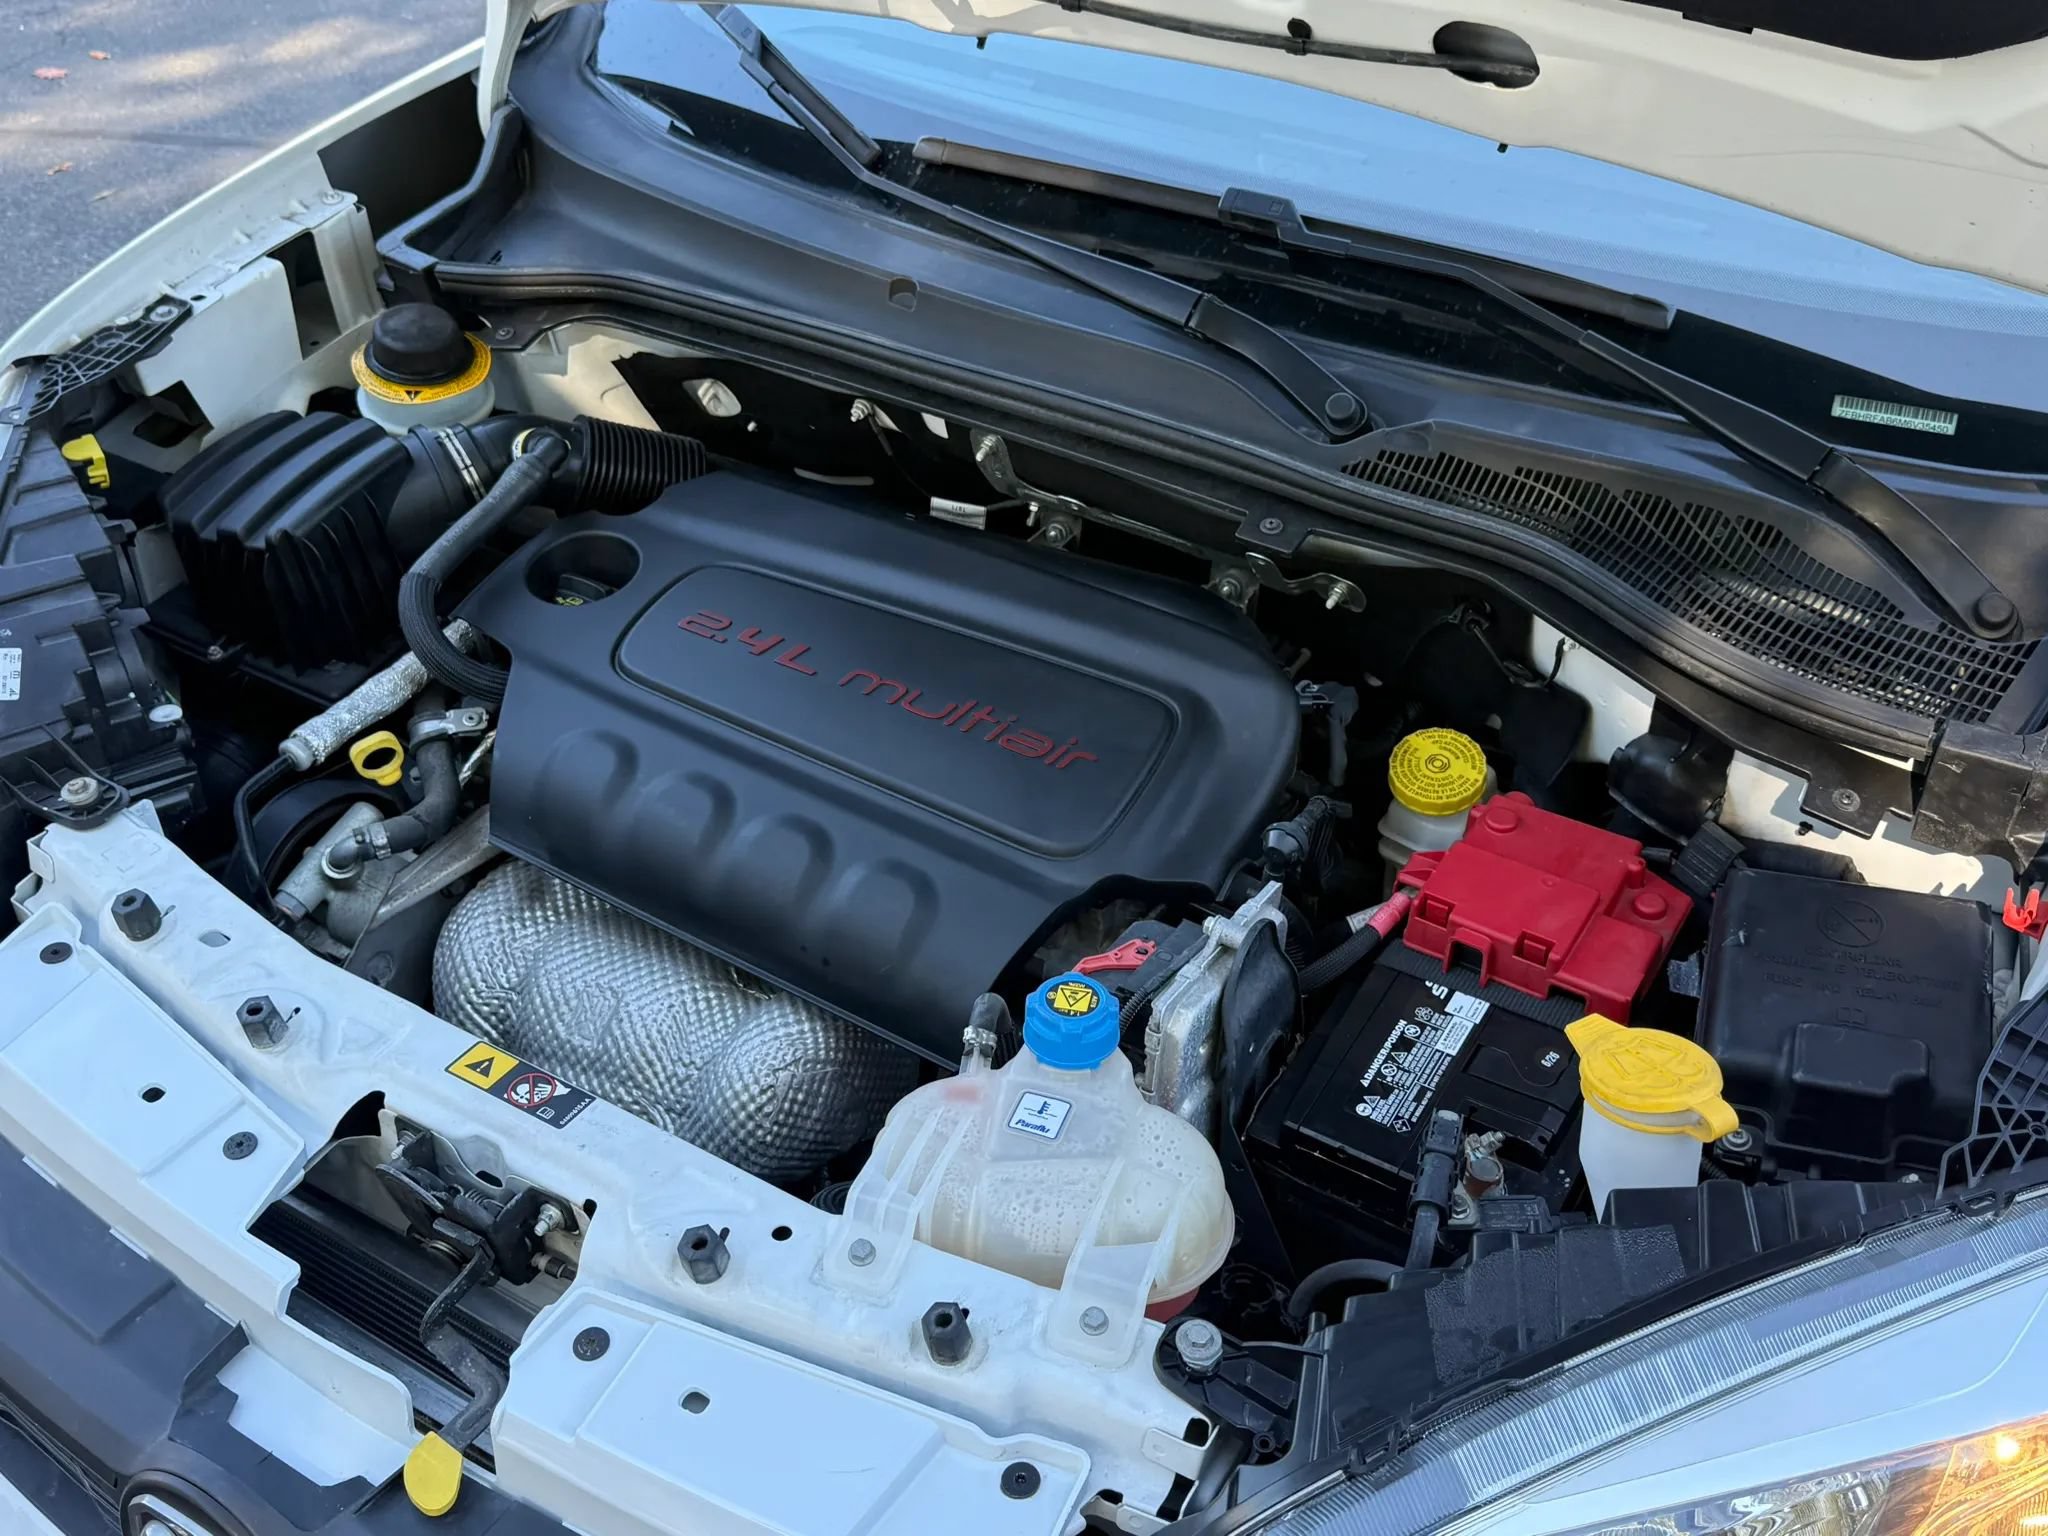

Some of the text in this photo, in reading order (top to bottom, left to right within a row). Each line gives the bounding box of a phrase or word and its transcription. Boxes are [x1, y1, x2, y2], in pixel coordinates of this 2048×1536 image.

[677, 610, 1100, 769] 2.4L multiair
[1364, 1018, 1408, 1080] DANGER/POISON
[1540, 1050, 1559, 1068] 6/26
[1015, 1118, 1050, 1134] Paraflu
